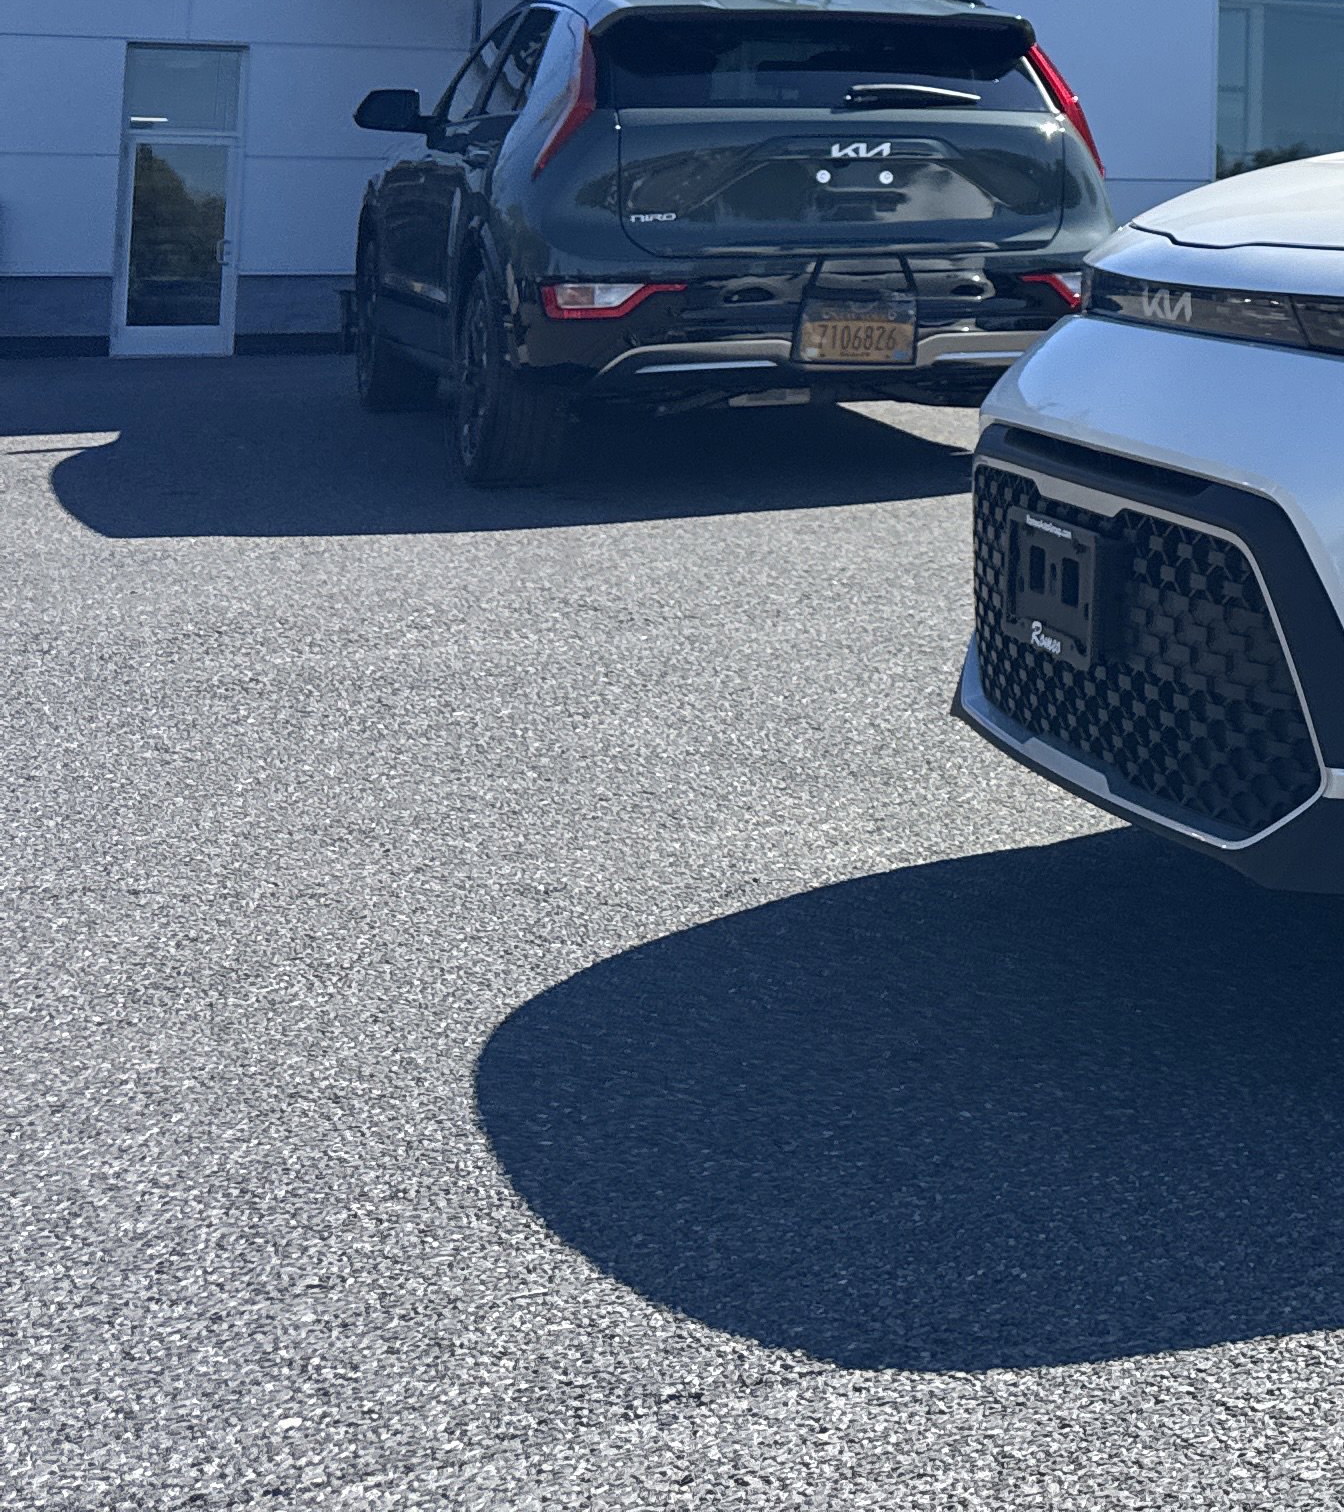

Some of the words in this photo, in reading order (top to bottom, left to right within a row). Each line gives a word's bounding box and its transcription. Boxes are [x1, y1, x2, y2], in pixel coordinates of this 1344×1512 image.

[831, 142, 891, 158] KIA
[1142, 282, 1192, 323] KIA
[817, 324, 898, 351] 7106826
